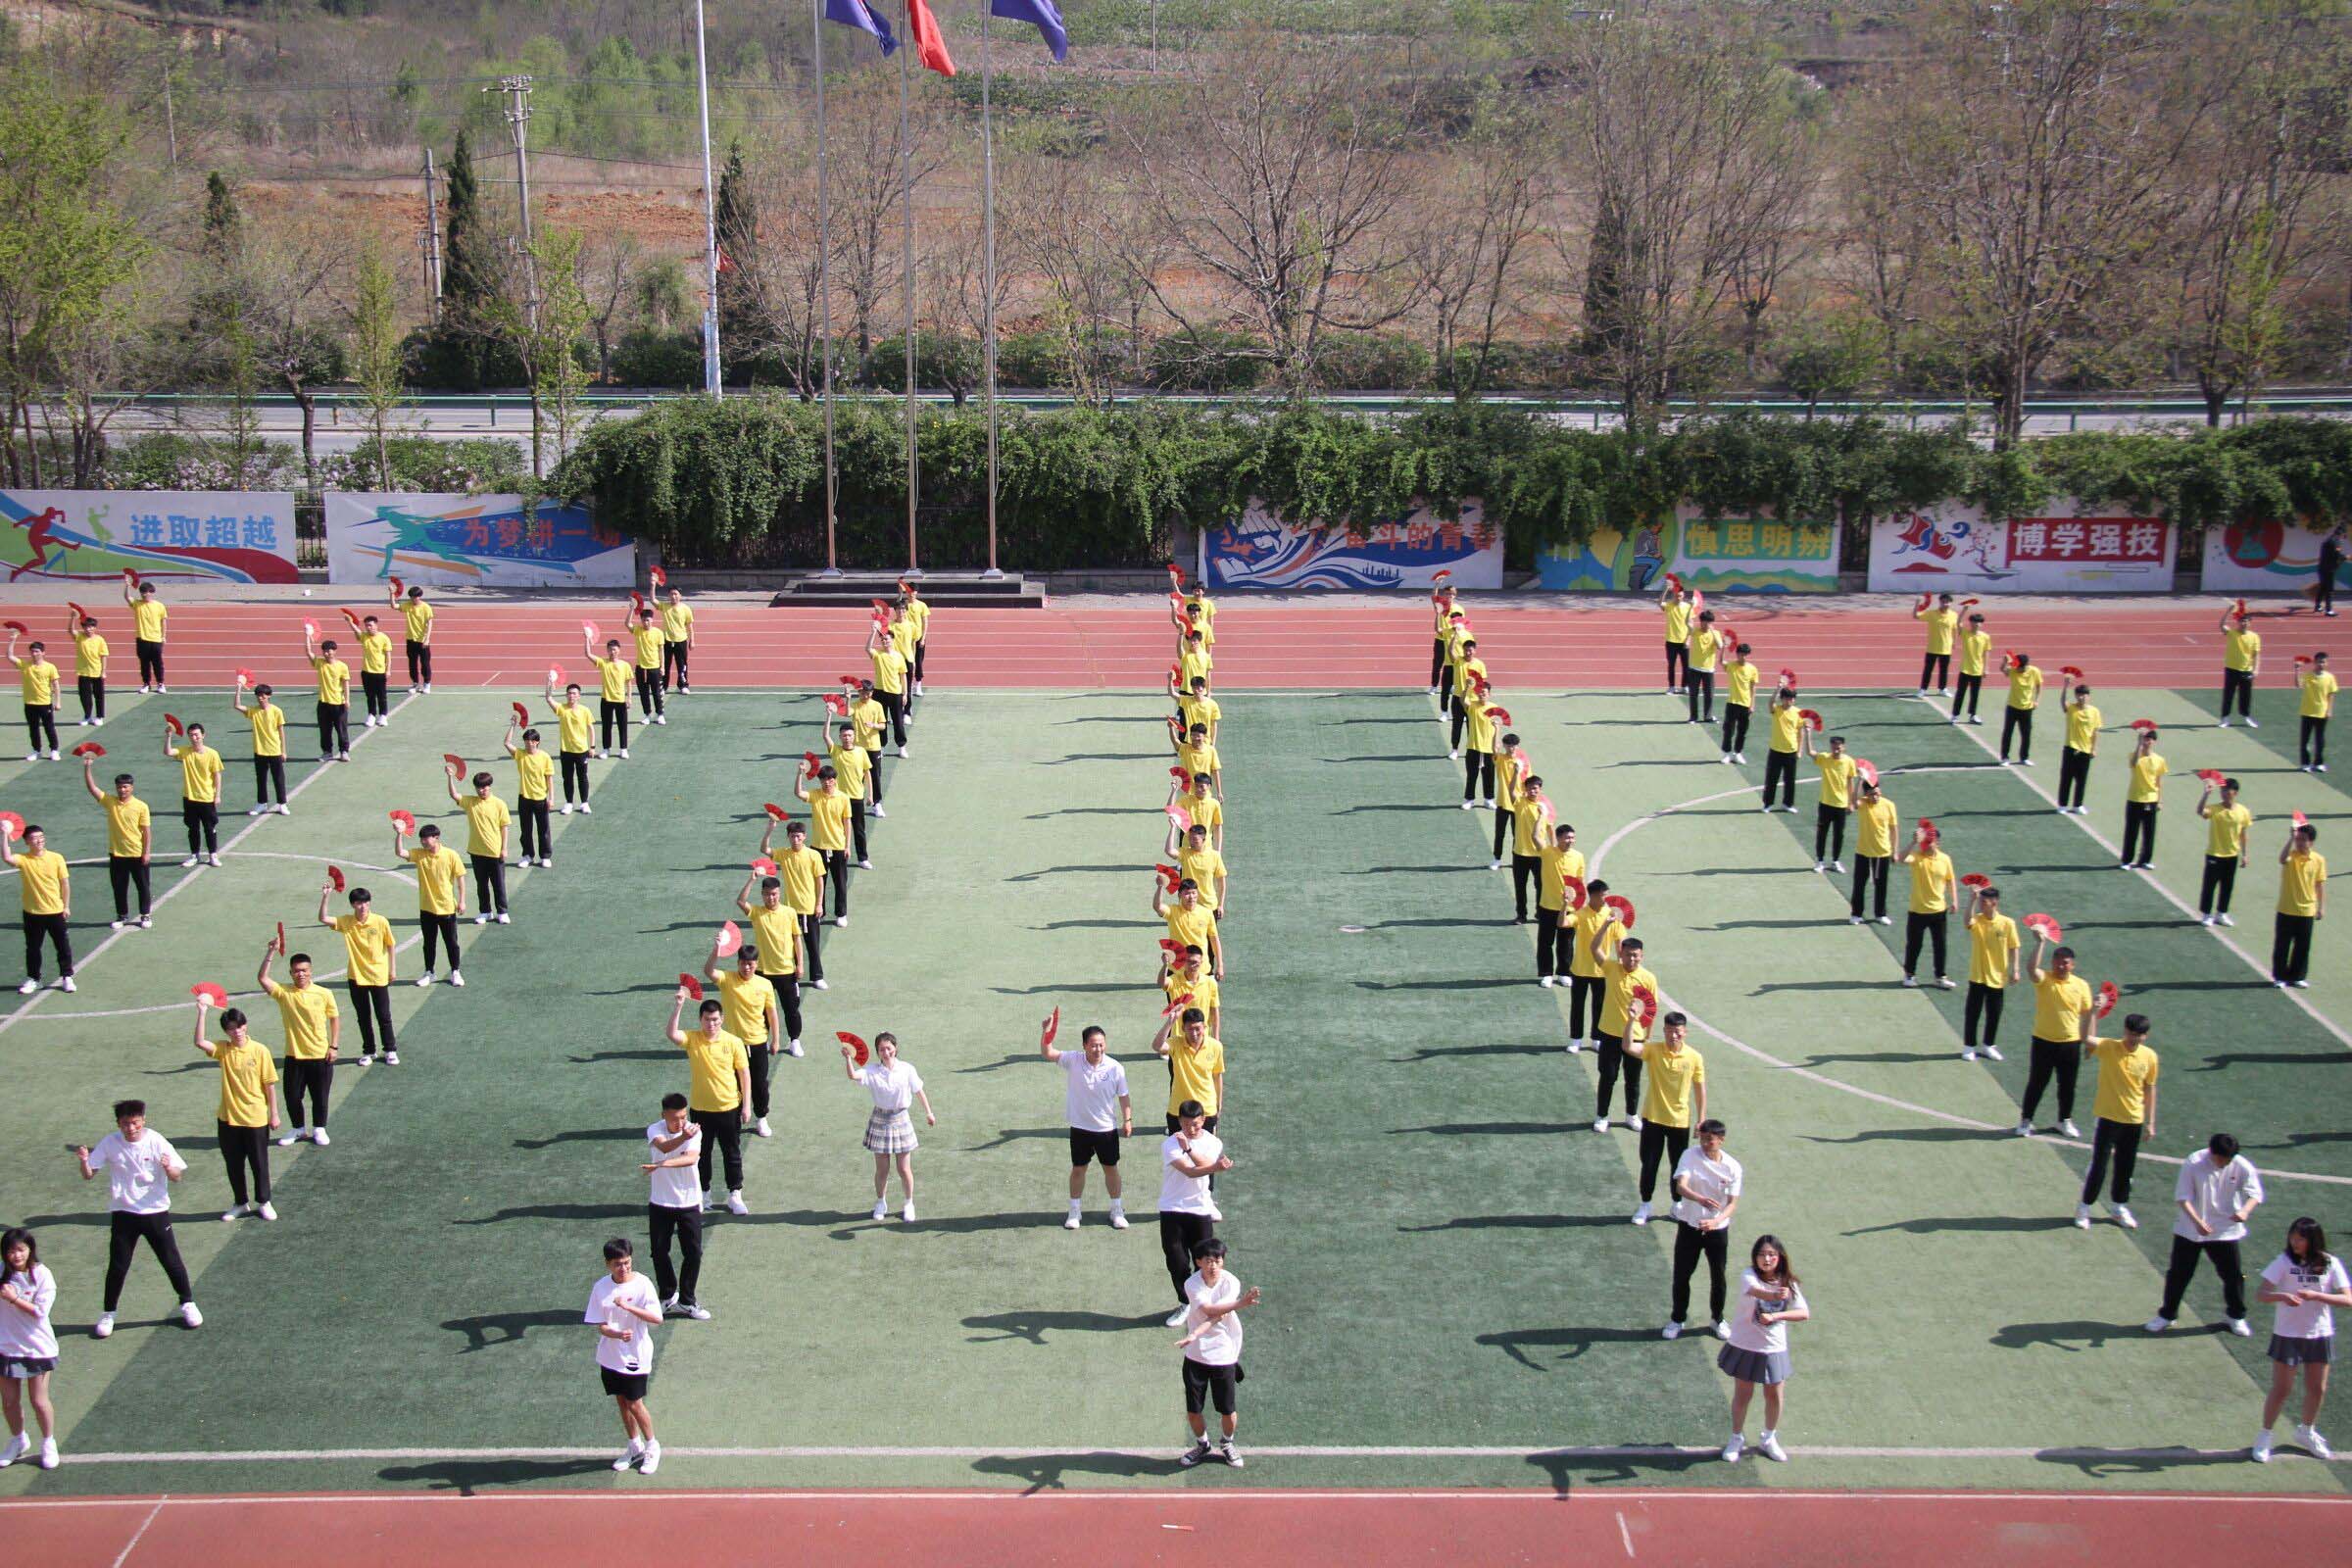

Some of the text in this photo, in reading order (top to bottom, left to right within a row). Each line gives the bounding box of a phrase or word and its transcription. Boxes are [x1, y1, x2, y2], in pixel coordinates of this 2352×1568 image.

[129, 514, 277, 550] 进取超越
[2014, 523, 2159, 557] 博学强技
